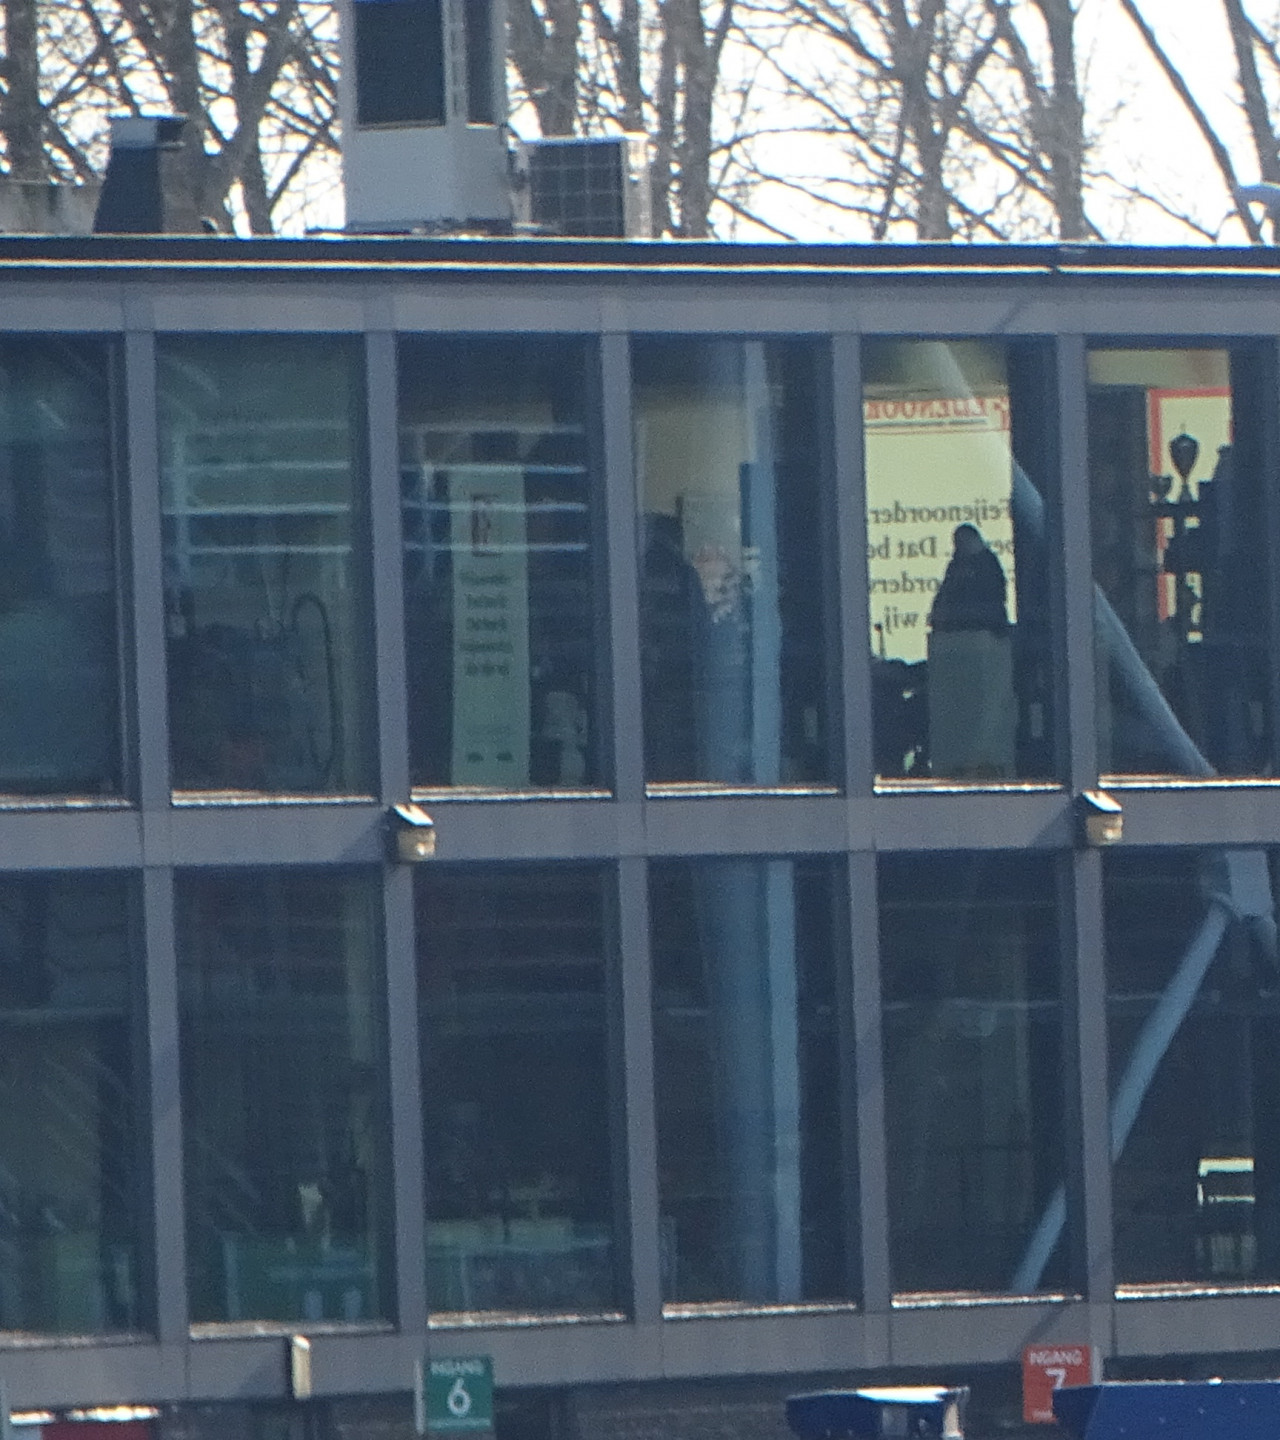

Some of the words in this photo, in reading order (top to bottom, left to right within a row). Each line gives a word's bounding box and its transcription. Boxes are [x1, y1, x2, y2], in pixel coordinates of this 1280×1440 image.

[1029, 1350, 1083, 1367] INGANG
[1045, 1367, 1066, 1390] 7
[447, 1377, 471, 1418] 6
